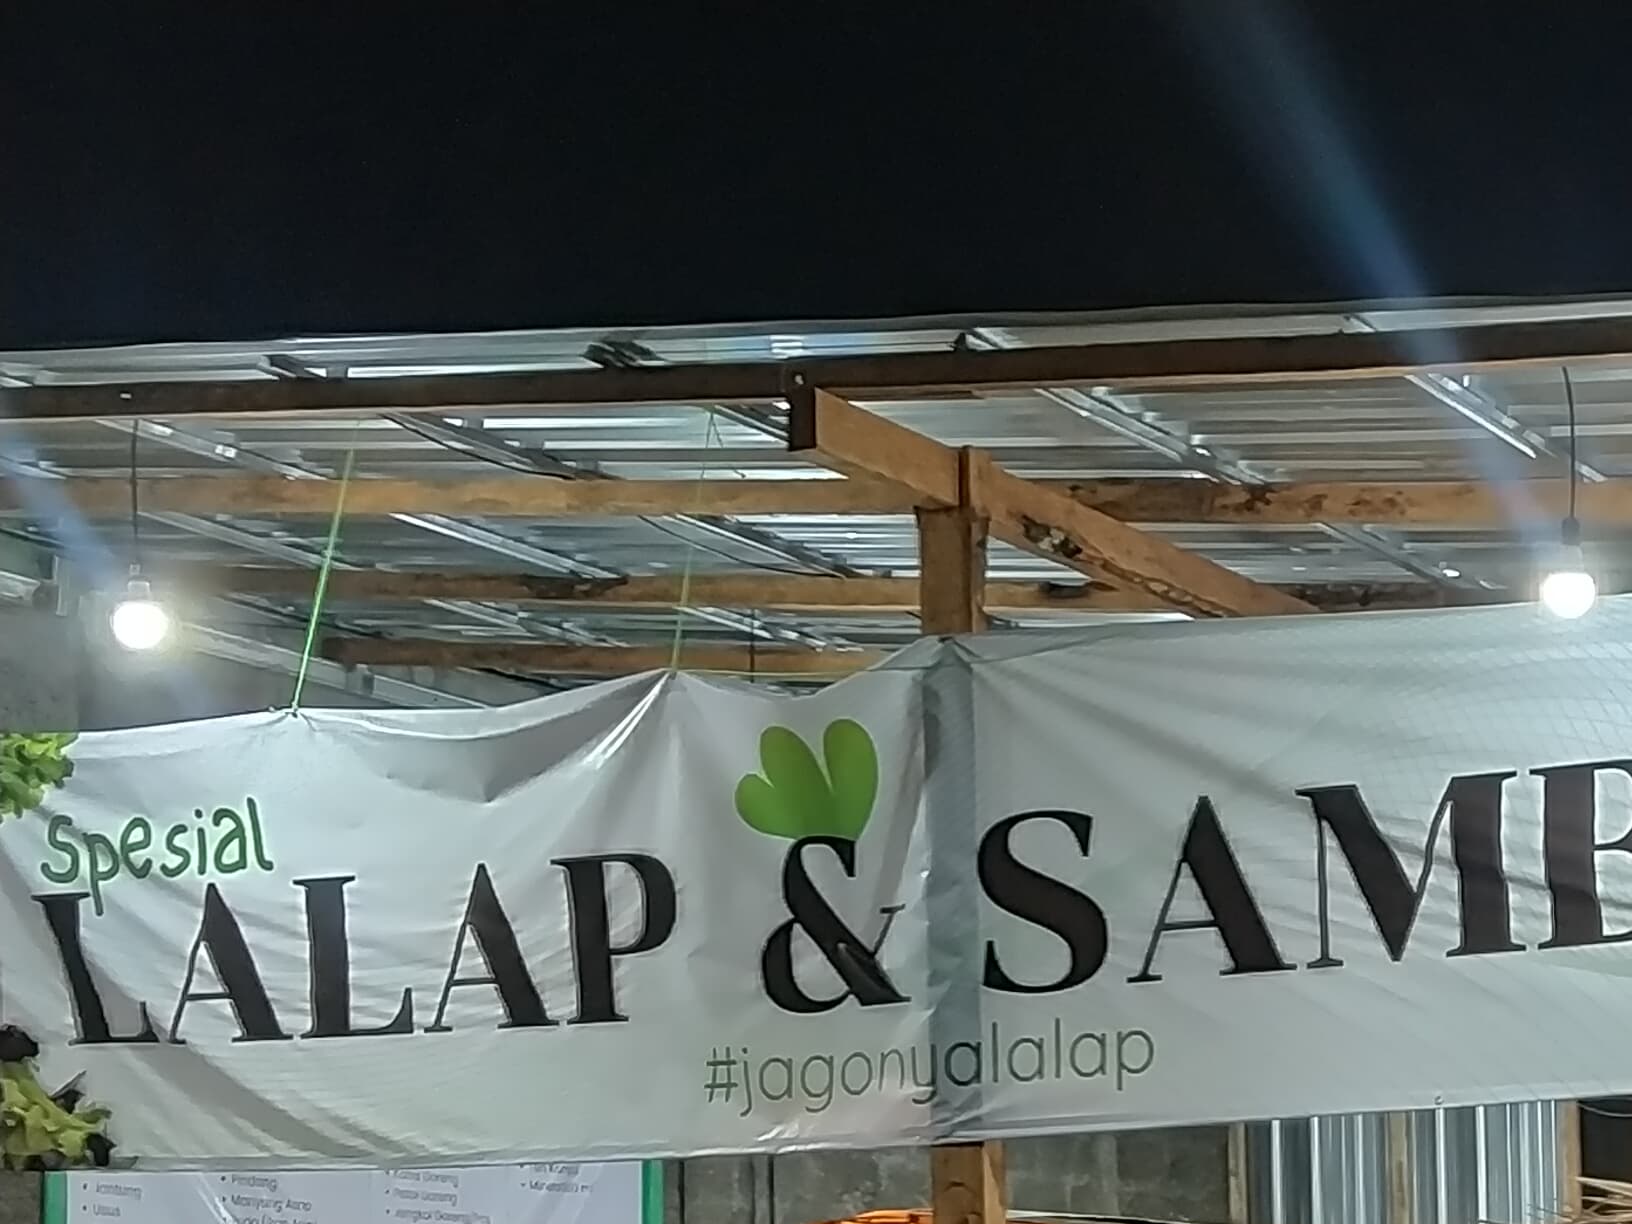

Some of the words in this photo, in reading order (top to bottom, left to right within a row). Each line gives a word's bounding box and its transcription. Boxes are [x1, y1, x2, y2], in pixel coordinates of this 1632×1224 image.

[40, 797, 275, 916] Spesial
[31, 852, 679, 1046] LALAP
[760, 835, 911, 1014] &
[704, 1017, 1155, 1118] #jagonyalalap
